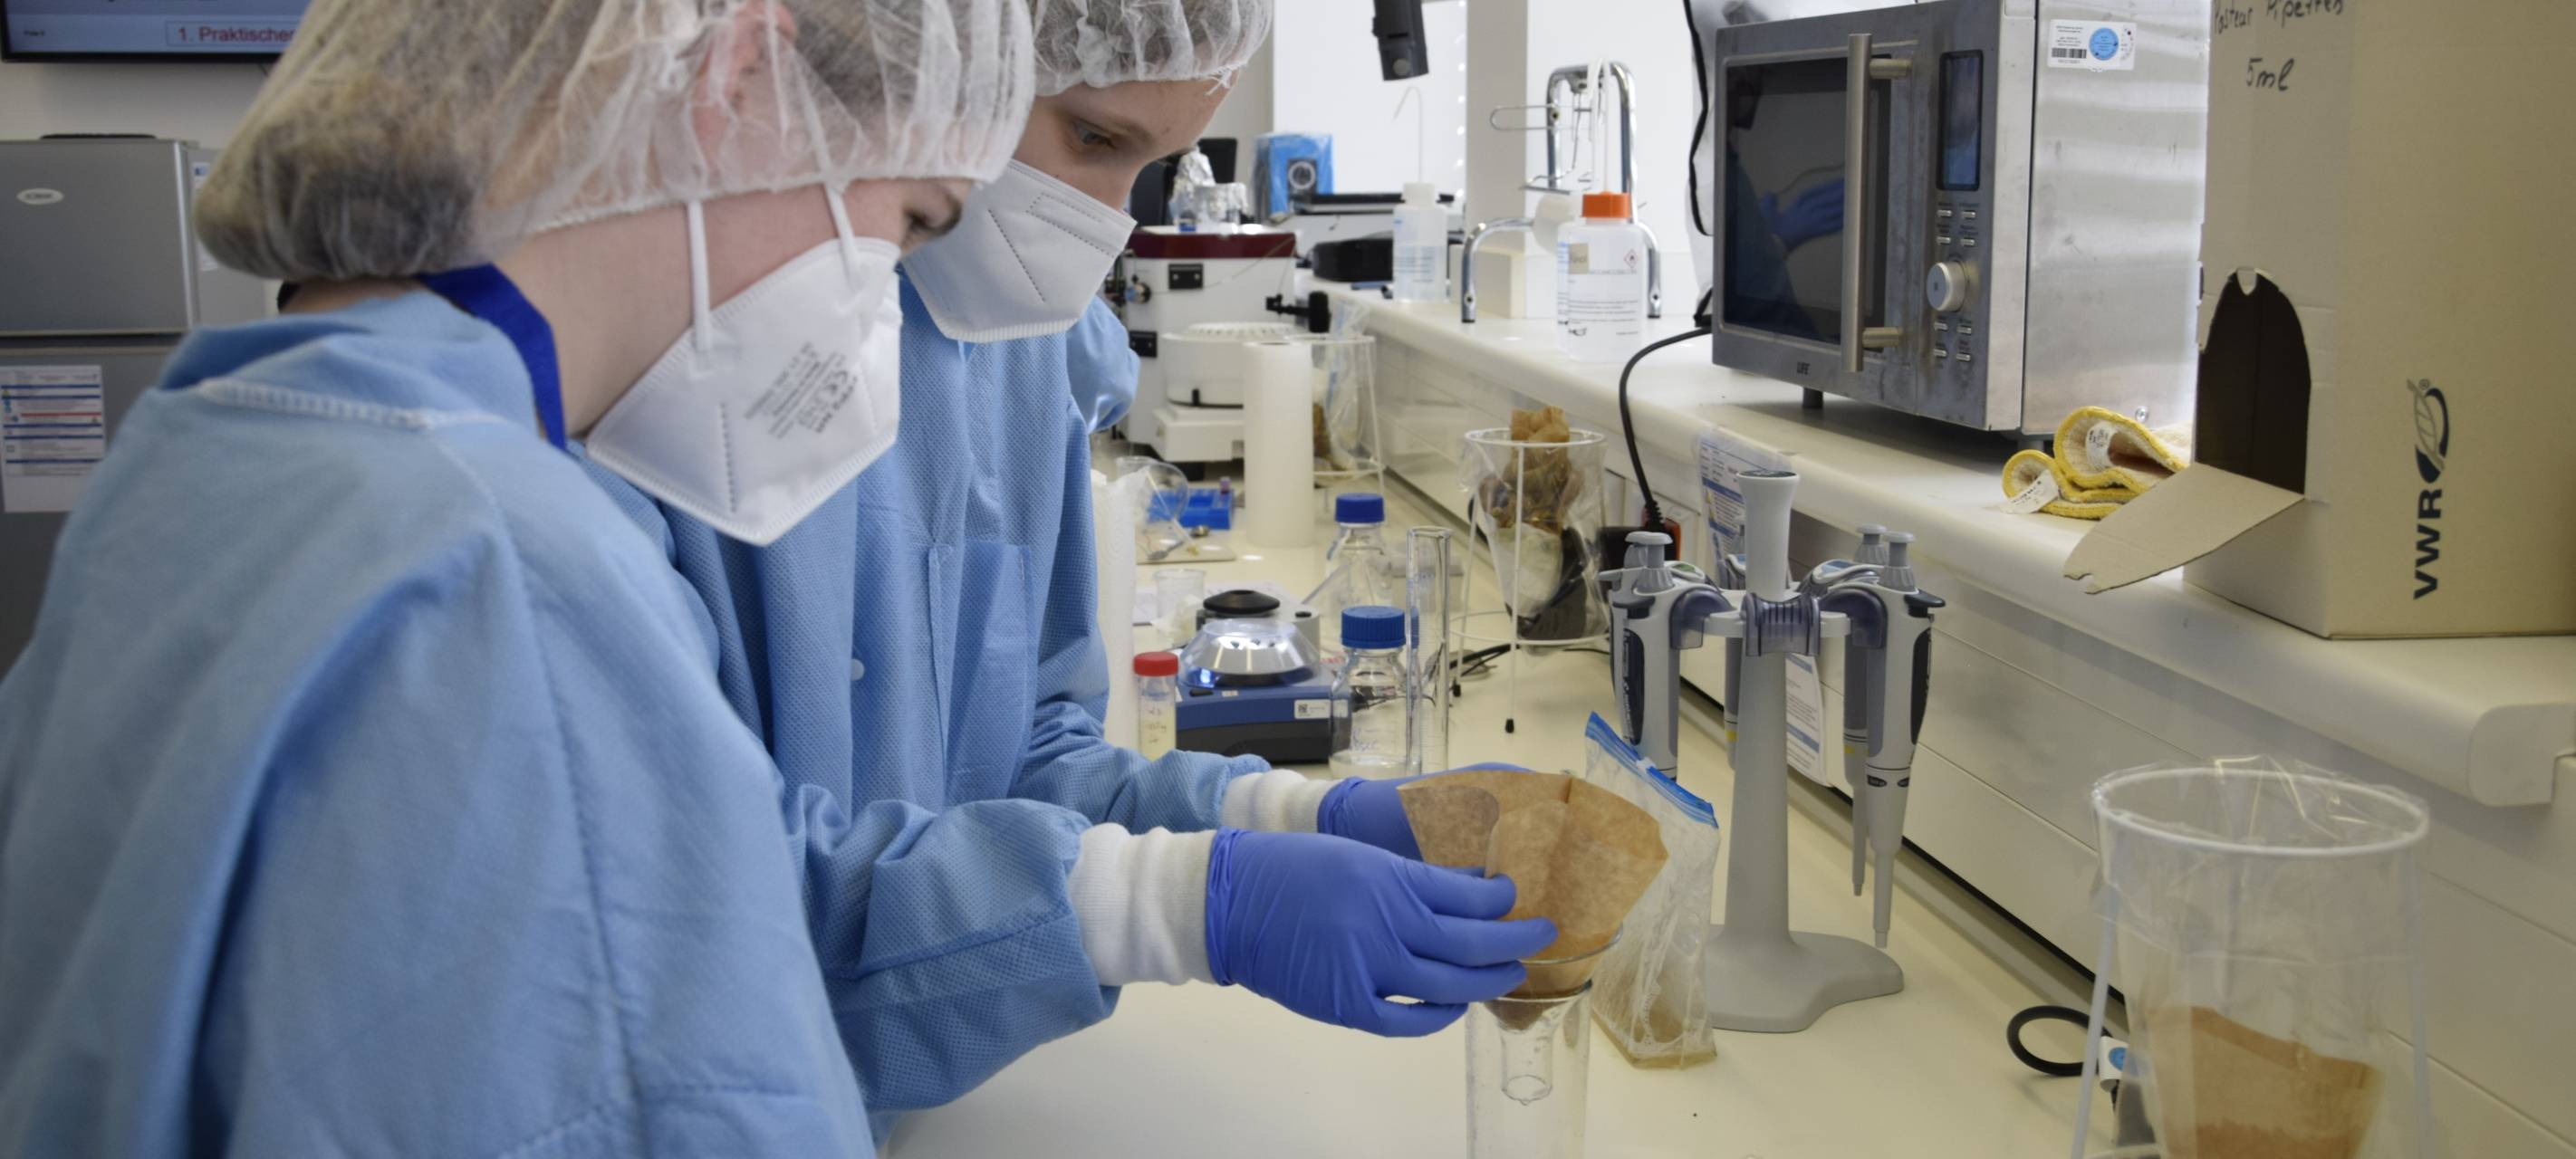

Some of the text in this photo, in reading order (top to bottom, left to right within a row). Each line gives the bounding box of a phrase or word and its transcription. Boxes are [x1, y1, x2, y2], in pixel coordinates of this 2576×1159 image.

[178, 27, 194, 42] 1.
[2246, 58, 2294, 91] 5ml
[2413, 489, 2443, 599] VWR
